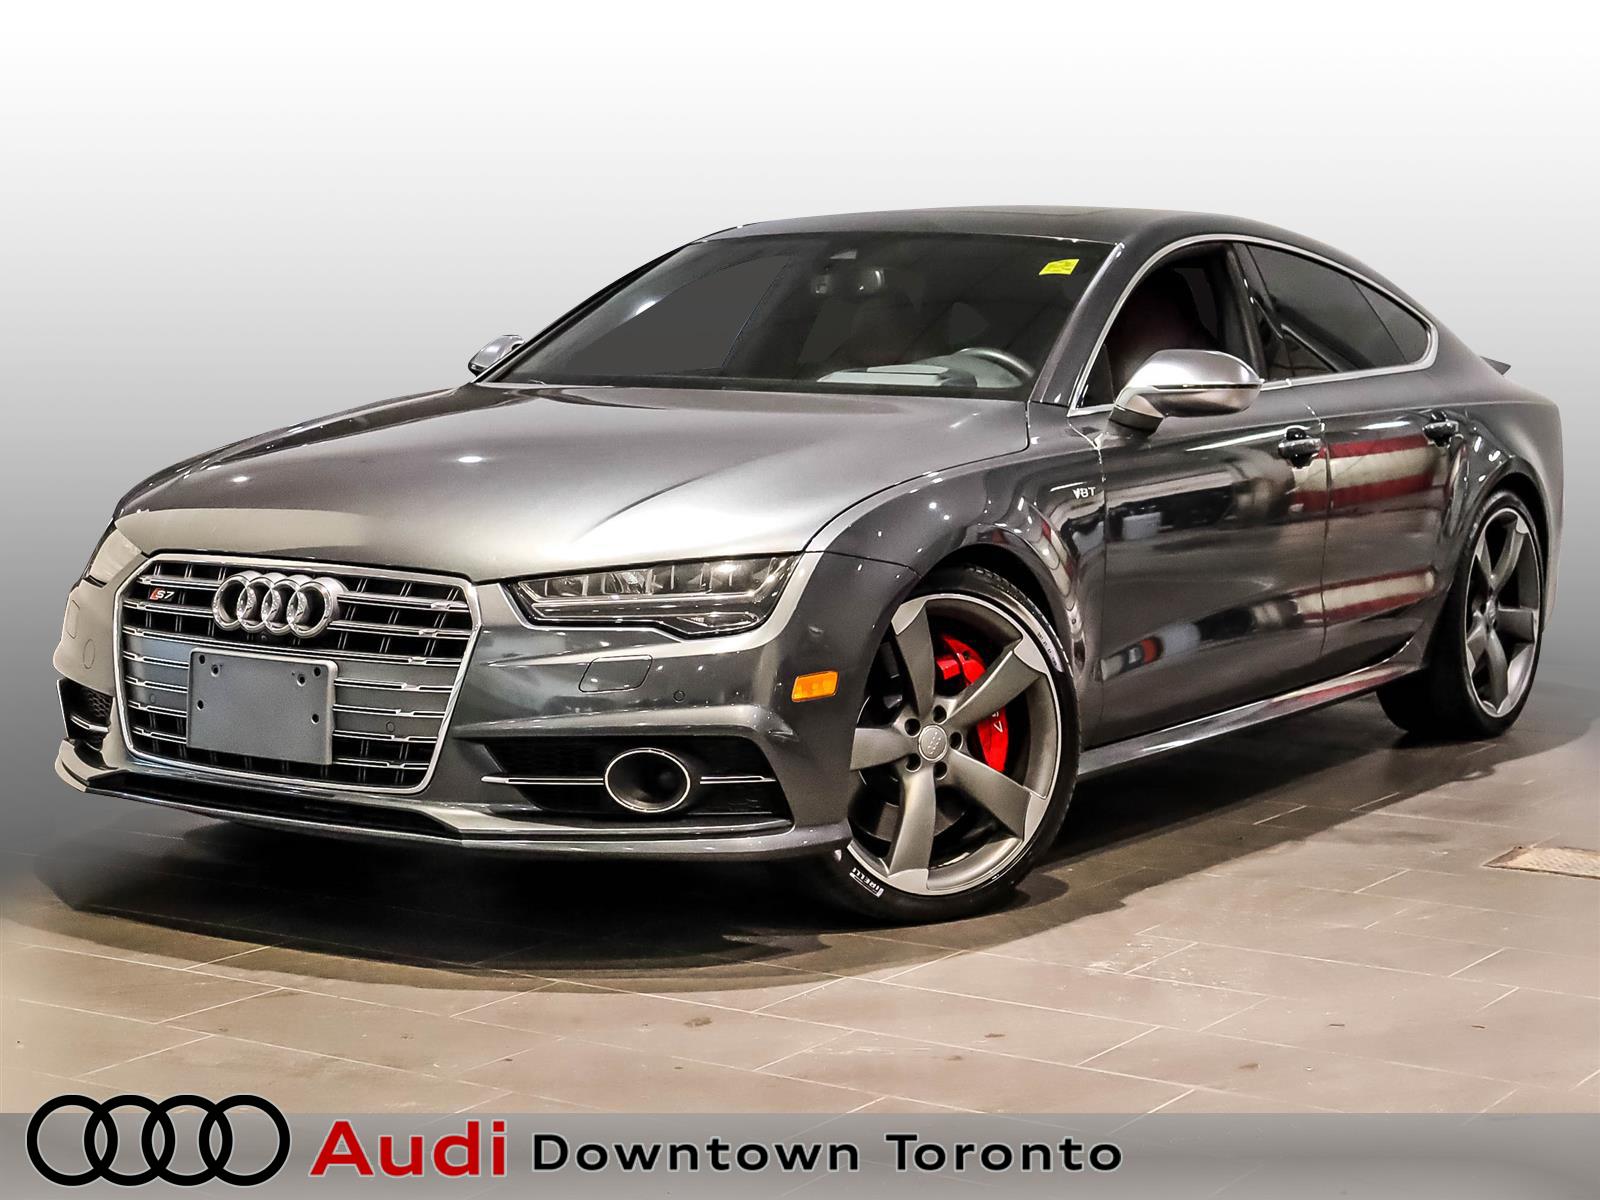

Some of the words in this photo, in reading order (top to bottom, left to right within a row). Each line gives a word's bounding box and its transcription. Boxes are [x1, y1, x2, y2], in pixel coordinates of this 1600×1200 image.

[1072, 486, 1096, 499] V8T
[155, 589, 175, 599] S7
[849, 867, 885, 898] PIRELLI
